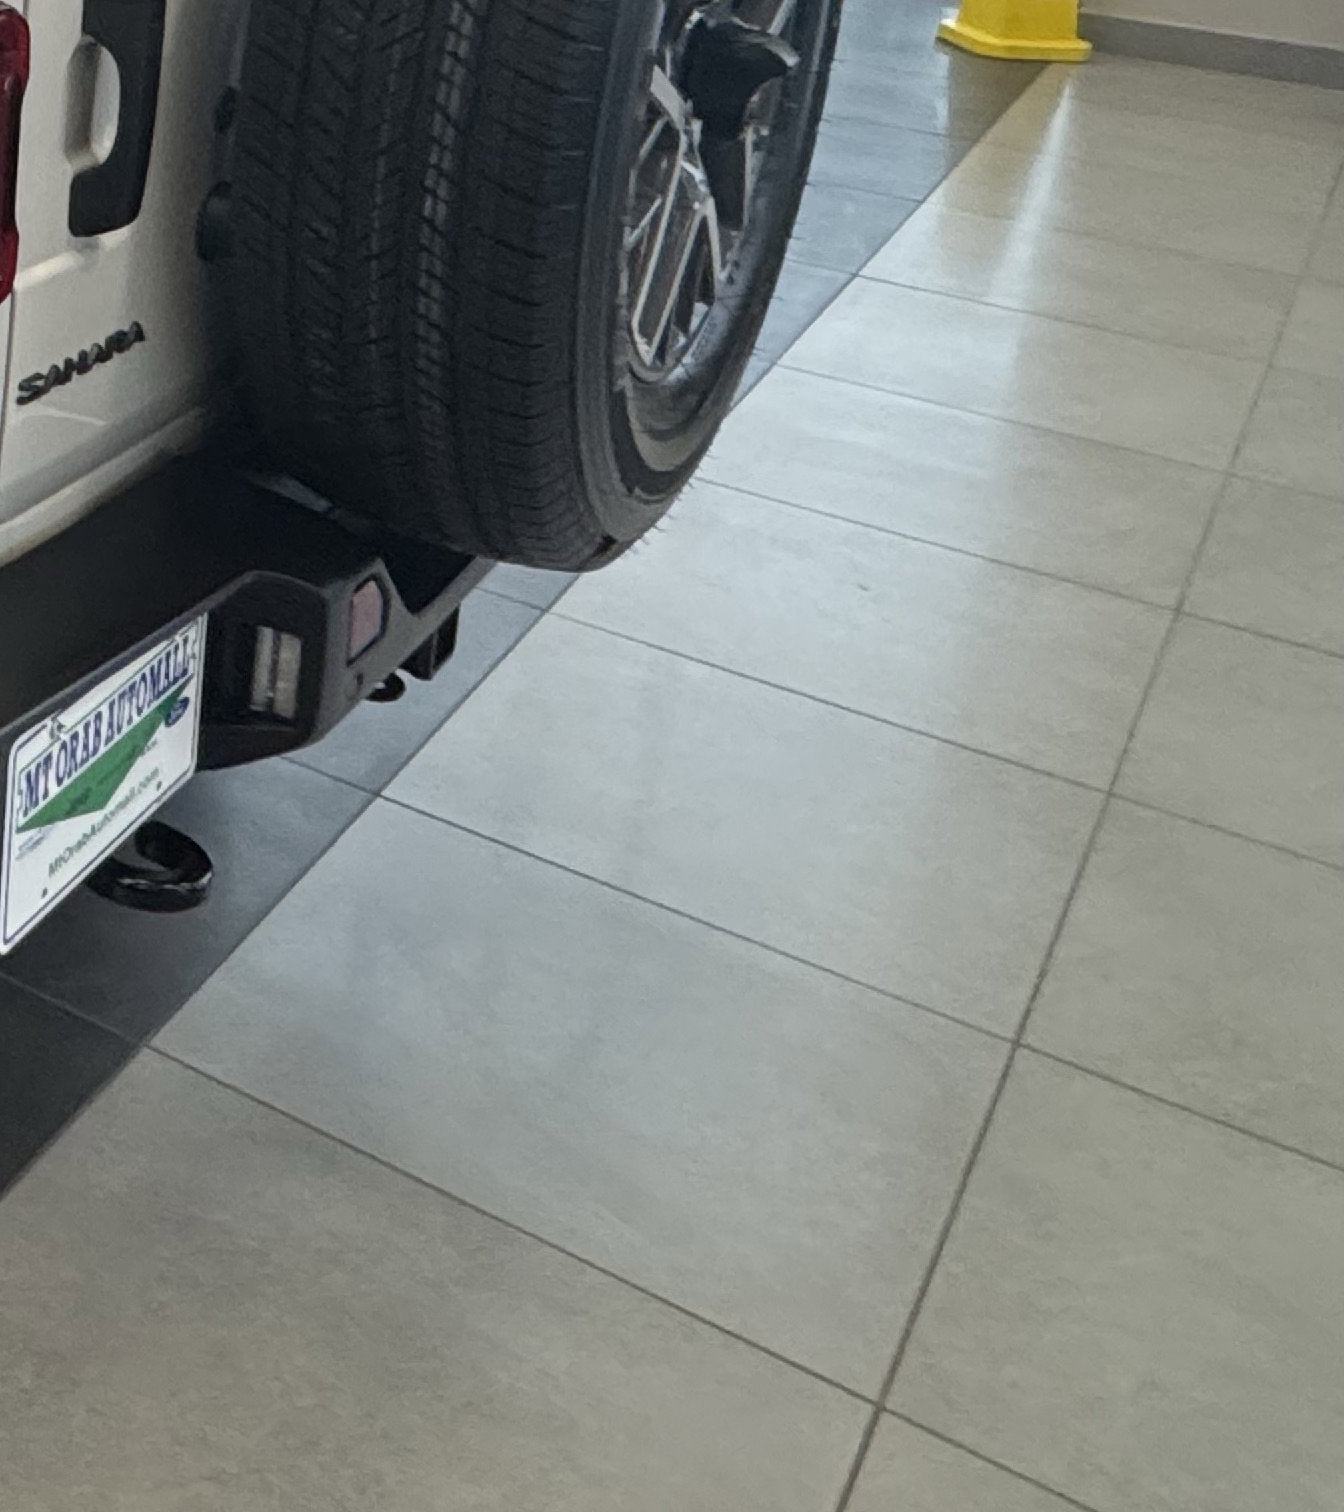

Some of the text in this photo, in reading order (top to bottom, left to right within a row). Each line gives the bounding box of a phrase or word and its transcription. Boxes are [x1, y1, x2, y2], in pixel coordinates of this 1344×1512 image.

[16, 320, 145, 405] SAHARA
[22, 750, 53, 818] MT
[55, 709, 104, 788] ORAB
[104, 634, 191, 745] AUTOMALL
